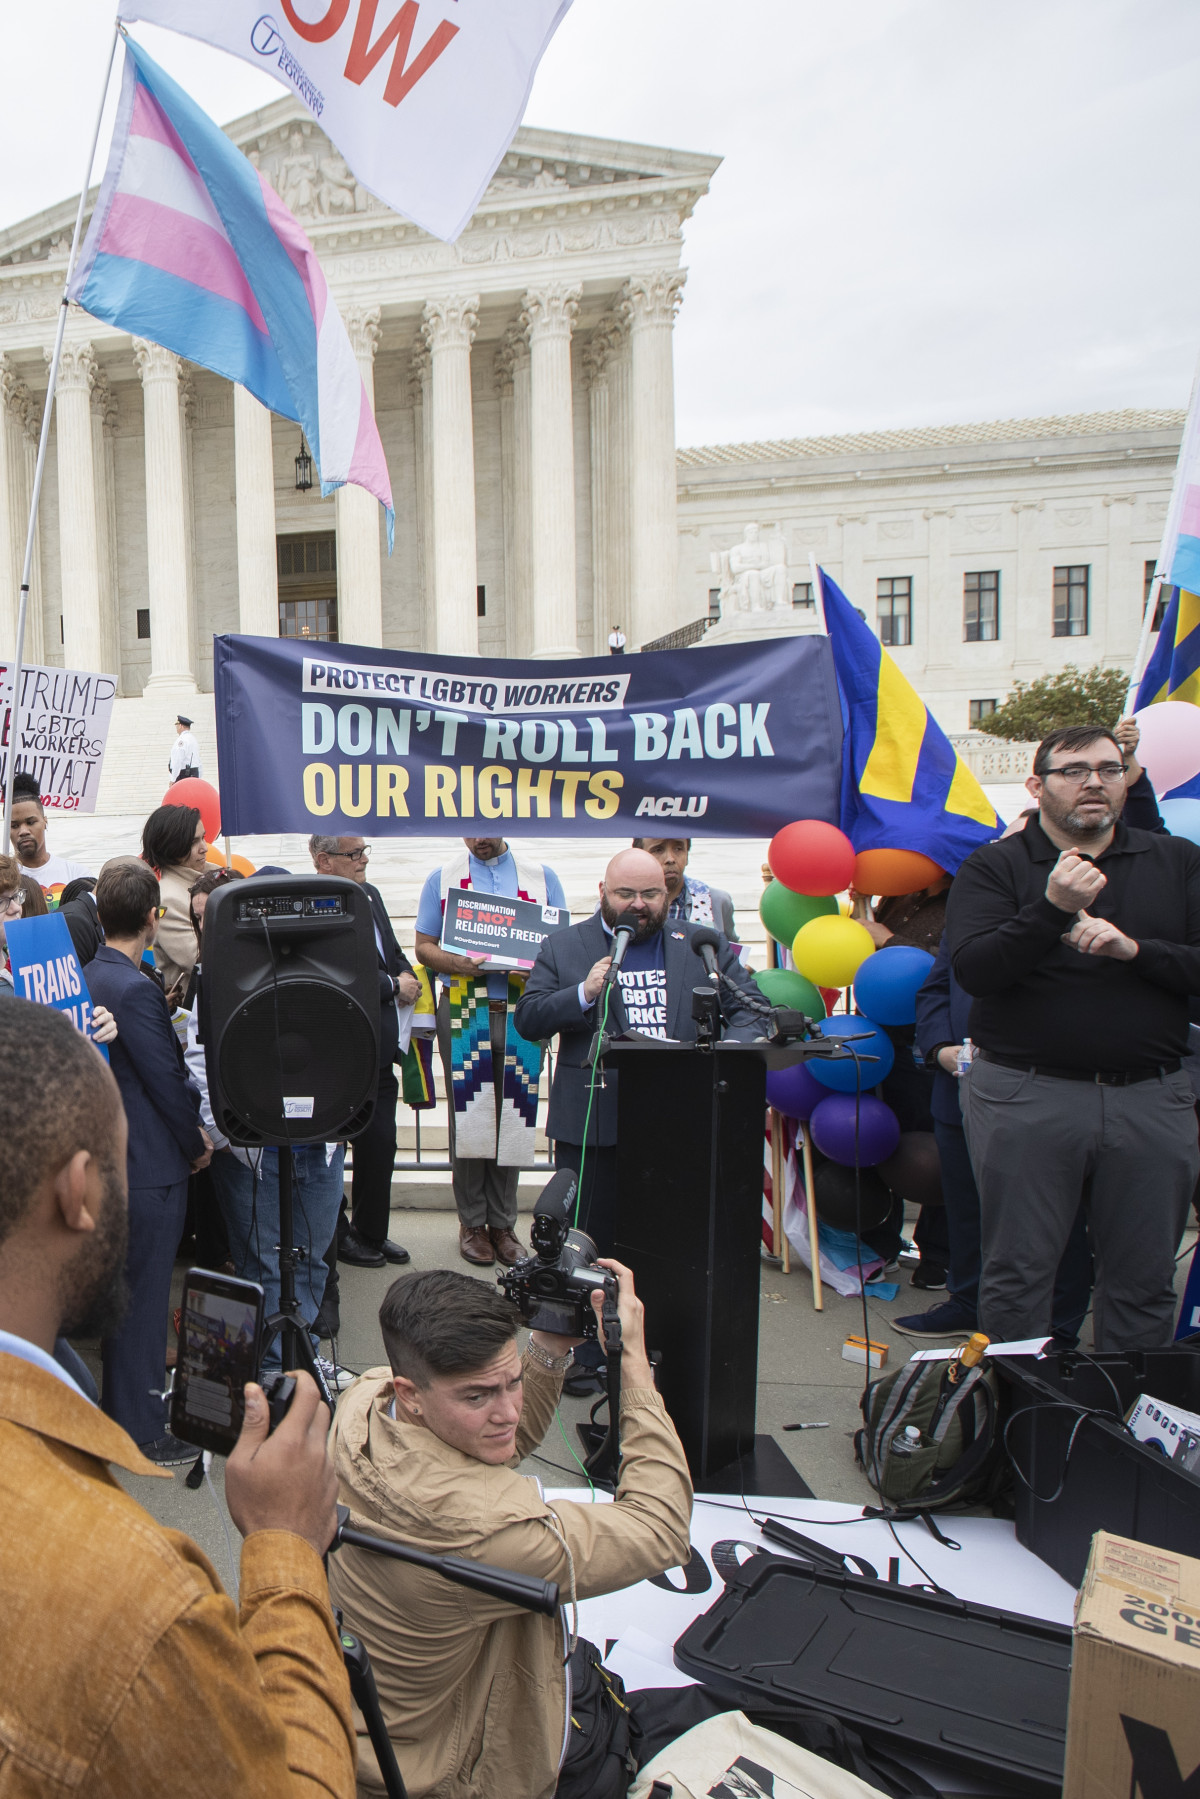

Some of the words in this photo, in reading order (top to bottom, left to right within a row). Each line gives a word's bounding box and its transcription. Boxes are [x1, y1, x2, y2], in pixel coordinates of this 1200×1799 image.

[277, 55, 323, 118] EQUALITY
[324, 255, 392, 278] UNDER
[19, 669, 116, 716] TRUMP
[310, 665, 415, 694] PROTECT
[420, 677, 498, 711] LGBTQ
[503, 680, 620, 708] WORKERS
[25, 713, 86, 737] LGBTQ
[302, 702, 468, 756] DON'T
[482, 717, 618, 763] ROLL
[629, 702, 775, 762] BACK
[21, 733, 103, 757] WORKERS
[57, 759, 97, 797] ACT
[302, 762, 410, 818] OUR
[424, 765, 624, 819] RIGHTS
[635, 796, 708, 818] ACLU
[456, 908, 474, 920] IS
[477, 912, 516, 927] NOT
[458, 899, 516, 917] DISCRIMINATION
[455, 919, 508, 938] RELIGIOUS
[19, 953, 81, 1005] TRANS
[625, 1006, 667, 1024] RKE
